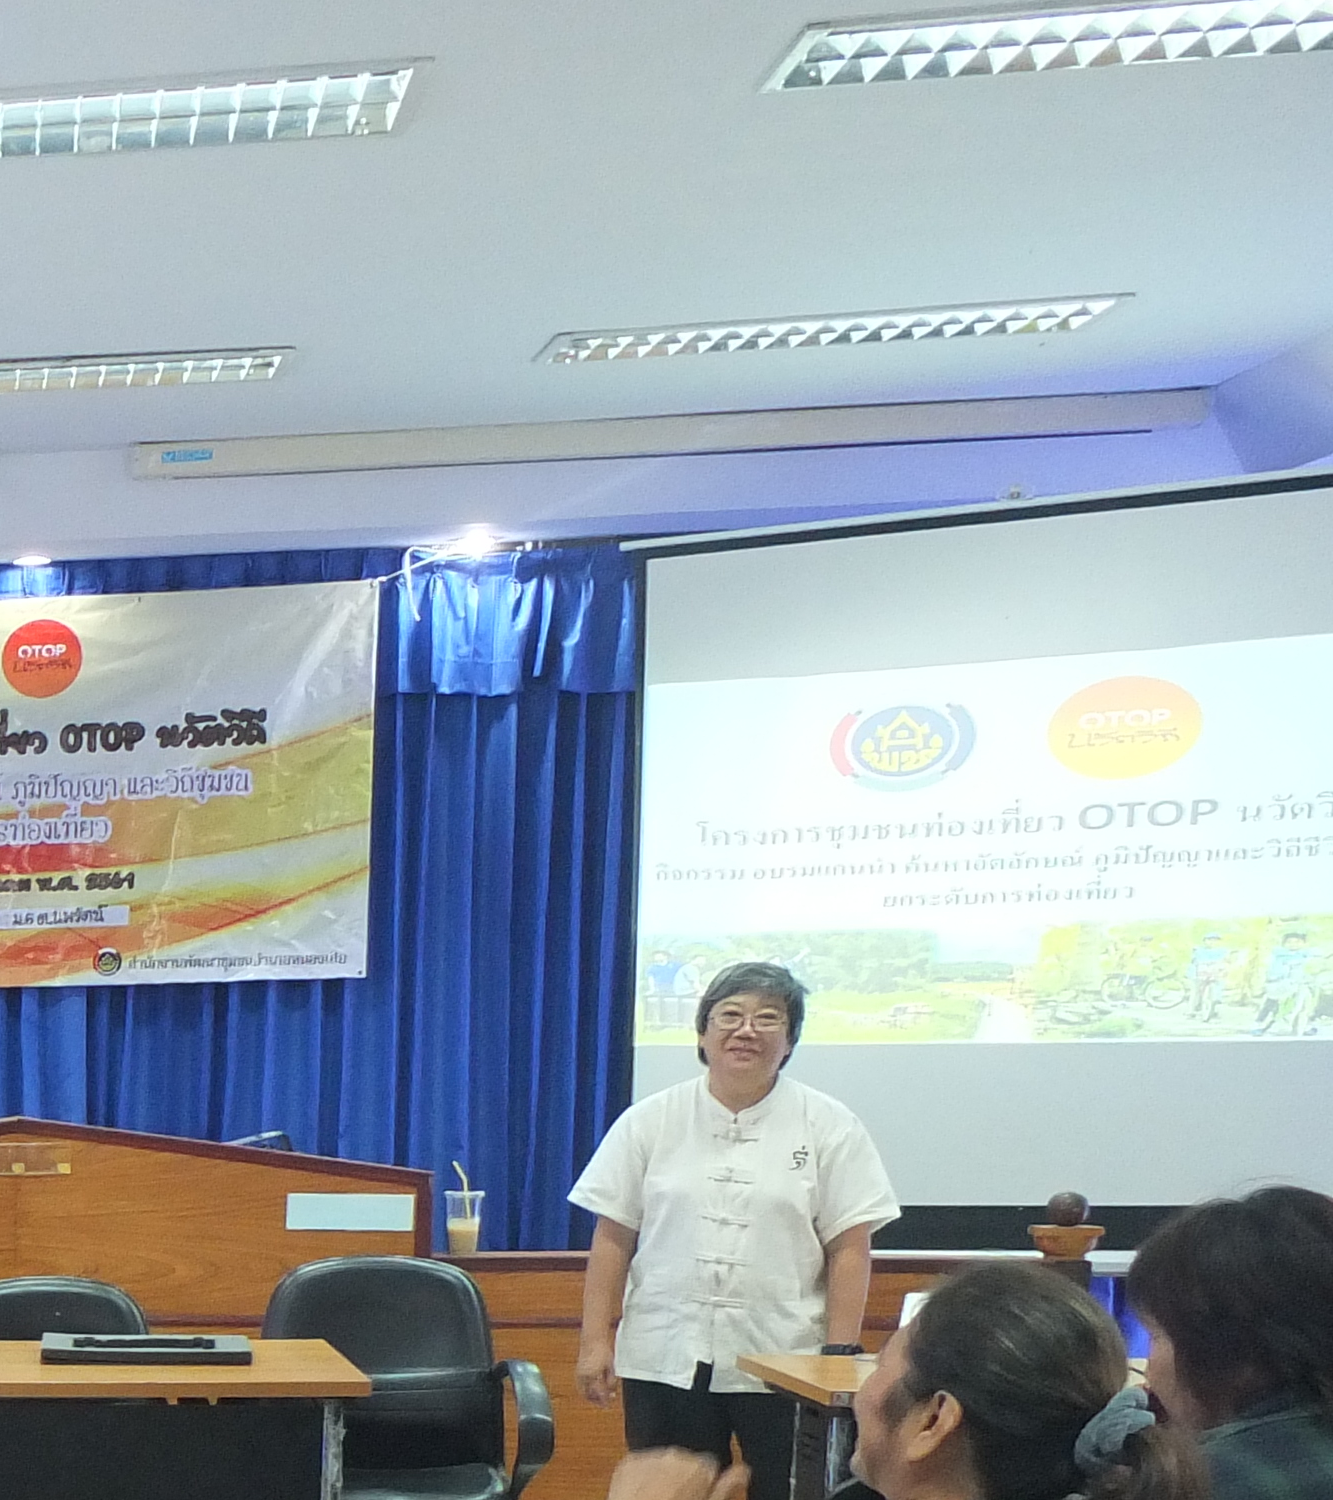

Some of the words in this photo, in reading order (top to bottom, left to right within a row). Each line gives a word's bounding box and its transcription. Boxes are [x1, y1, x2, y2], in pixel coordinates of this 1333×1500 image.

[18, 643, 67, 659] OTOP
[1078, 707, 1172, 731] OTOP
[60, 721, 145, 754] OTOP
[11, 773, 118, 807] ภูมิปัญญา
[127, 767, 251, 804] และวิถีชุมชน
[696, 799, 1065, 849] โครงการชุมชนท่องเที่ยว
[1078, 798, 1219, 830] OTOP
[84, 871, 136, 891] 2561
[883, 874, 1136, 908] ยกระดับการท่องเที่ยว
